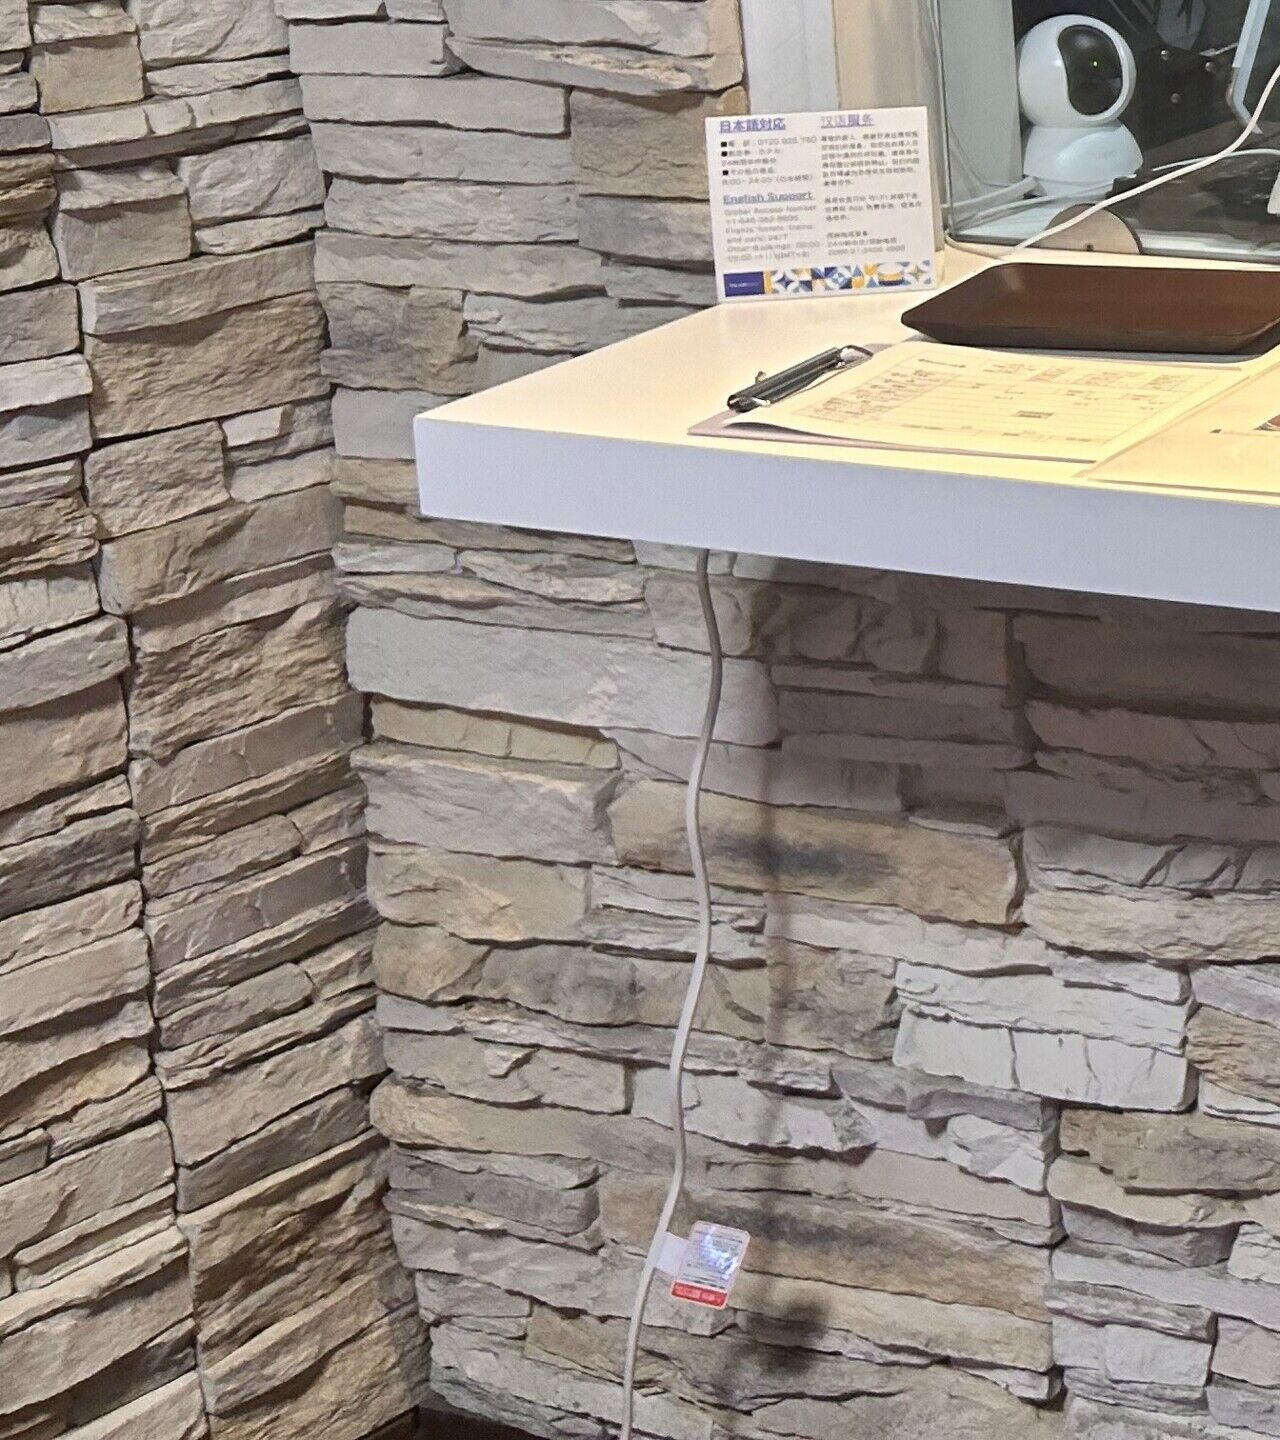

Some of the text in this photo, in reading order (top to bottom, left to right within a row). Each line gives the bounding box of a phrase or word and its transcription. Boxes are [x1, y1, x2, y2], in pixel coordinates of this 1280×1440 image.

[718, 117, 786, 134] 日本語対応
[722, 193, 765, 206] English
